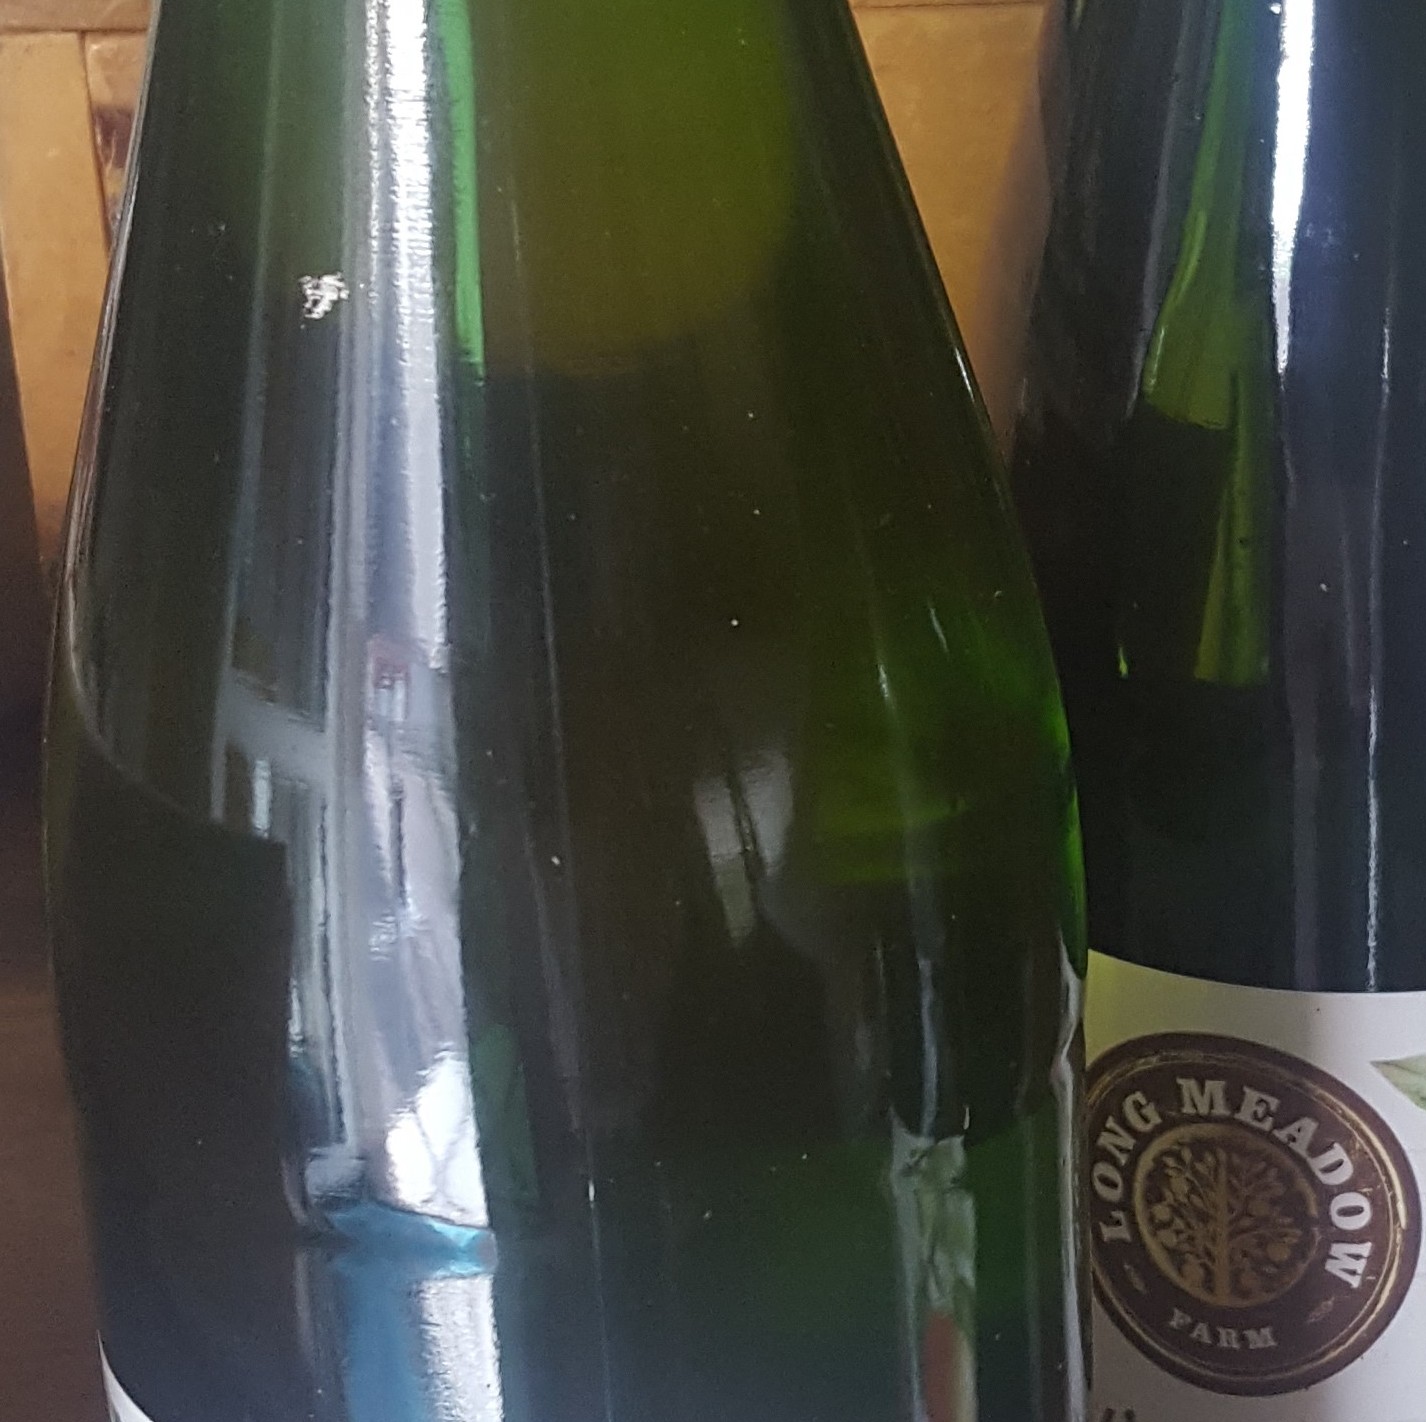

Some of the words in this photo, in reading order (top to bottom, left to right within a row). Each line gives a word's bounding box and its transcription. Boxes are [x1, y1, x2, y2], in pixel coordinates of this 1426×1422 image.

[1093, 1090, 1163, 1244] LONG
[1175, 1077, 1373, 1290] MEADOW
[1167, 1307, 1278, 1350] FARM
